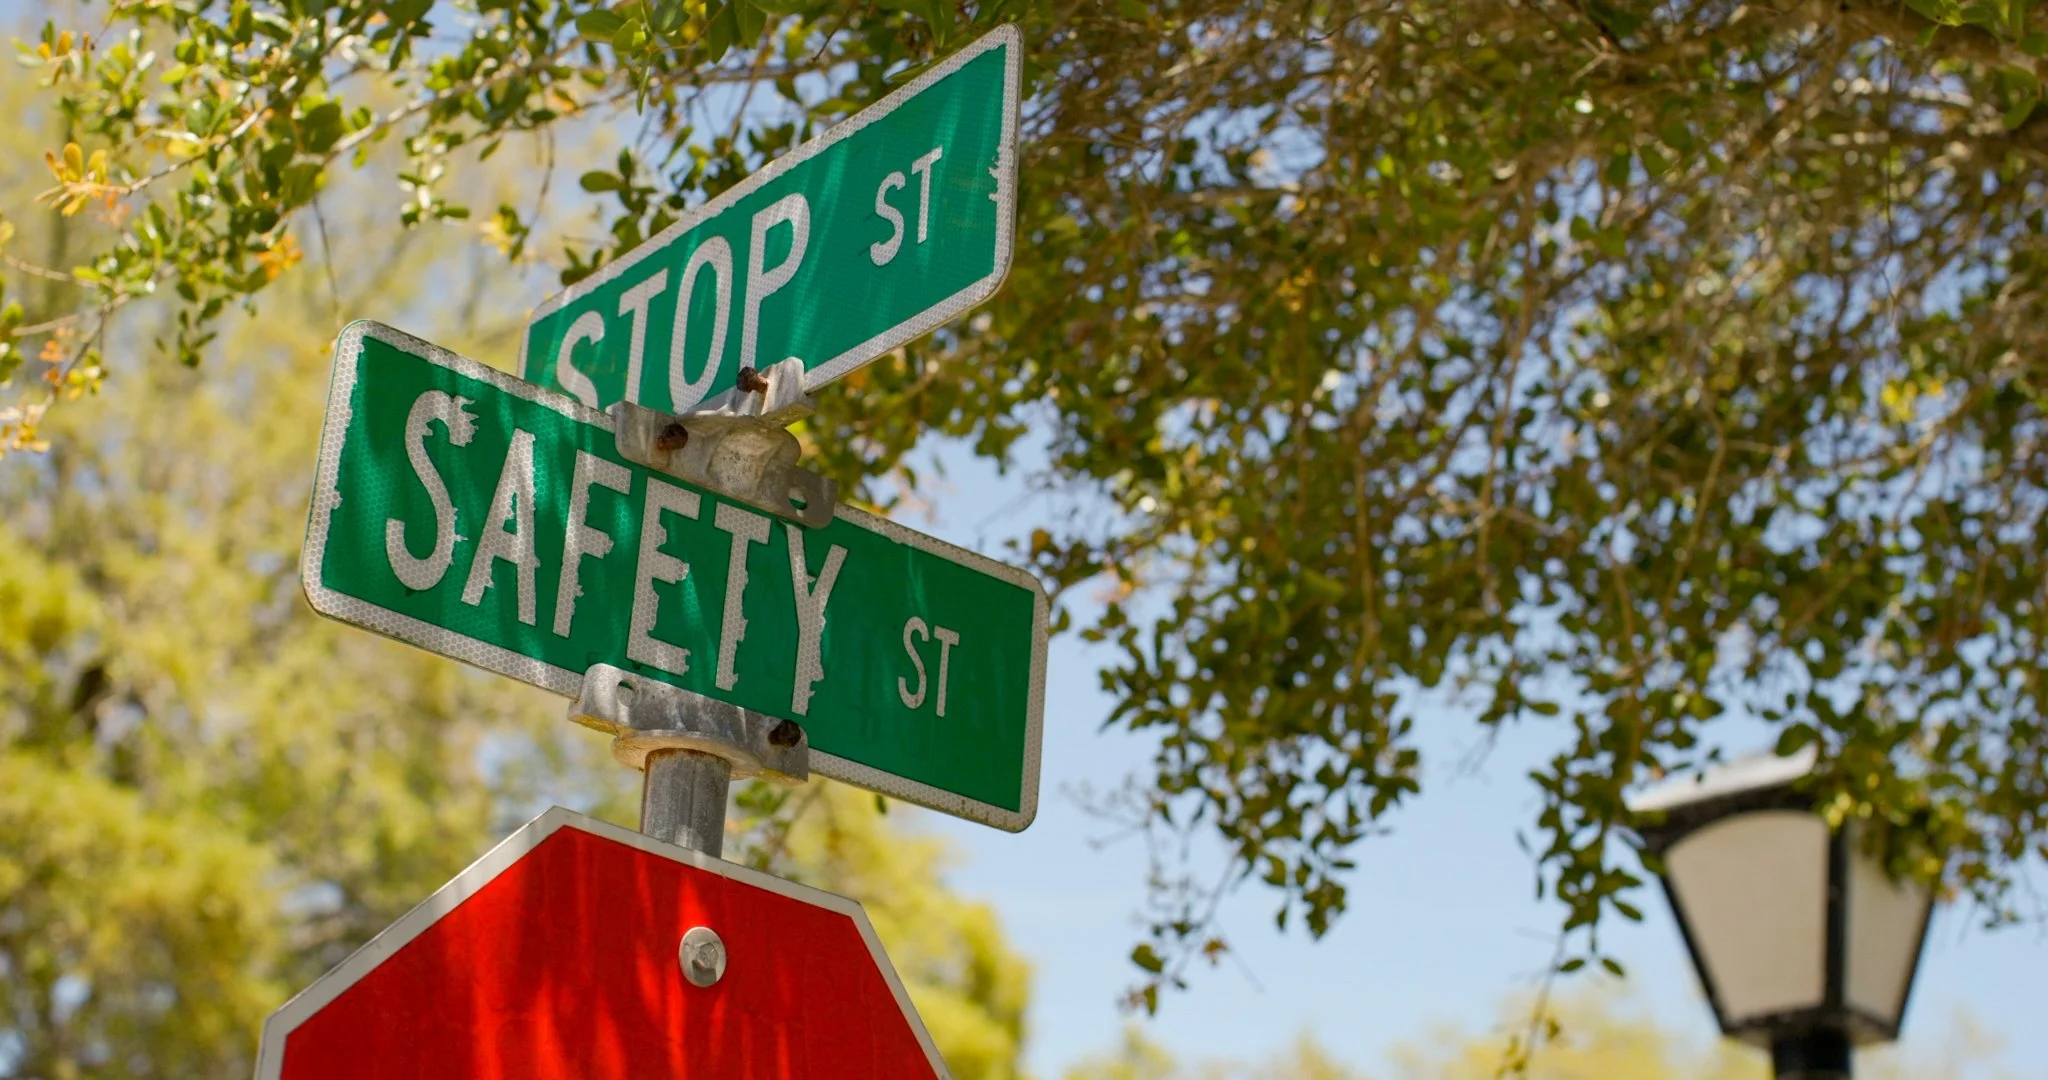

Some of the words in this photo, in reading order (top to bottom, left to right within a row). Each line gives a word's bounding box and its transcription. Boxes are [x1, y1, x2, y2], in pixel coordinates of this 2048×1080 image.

[556, 193, 811, 414] STOP
[870, 146, 943, 267] ST
[385, 389, 849, 716] SAFETY
[898, 616, 960, 718] ST
